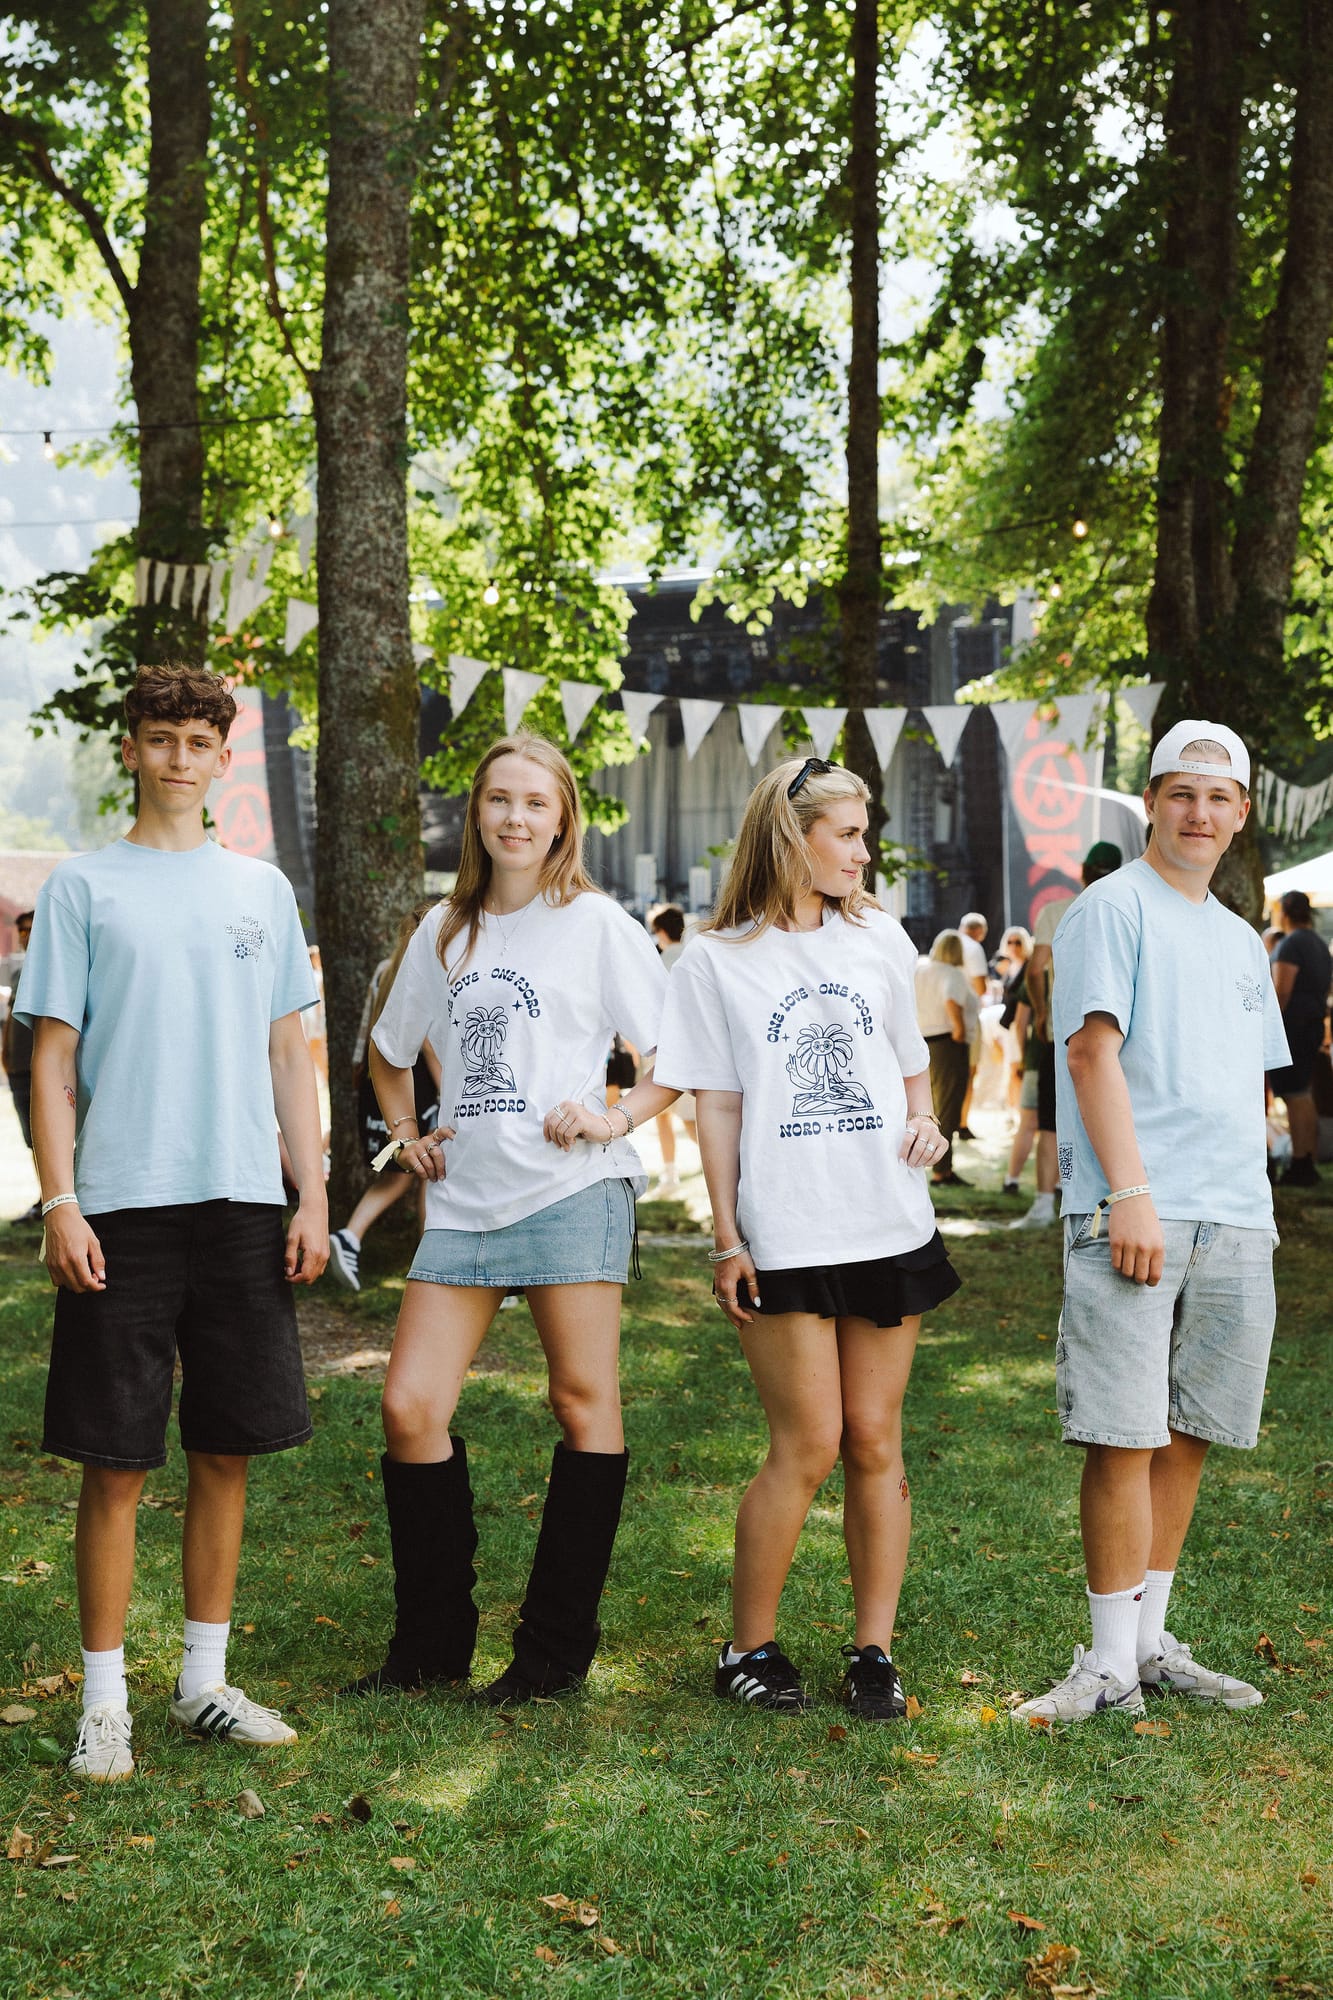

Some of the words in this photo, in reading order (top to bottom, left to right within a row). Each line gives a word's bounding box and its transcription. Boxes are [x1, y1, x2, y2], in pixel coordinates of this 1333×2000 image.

[450, 971, 480, 998] LOVE
[491, 967, 517, 982] ONE
[767, 1012, 785, 1043] ONE
[780, 987, 809, 1012] LOVE
[819, 983, 849, 998] ONE
[484, 1099, 526, 1113] FJORD
[779, 1121, 821, 1138] NORD
[838, 1115, 883, 1133] FJORD
